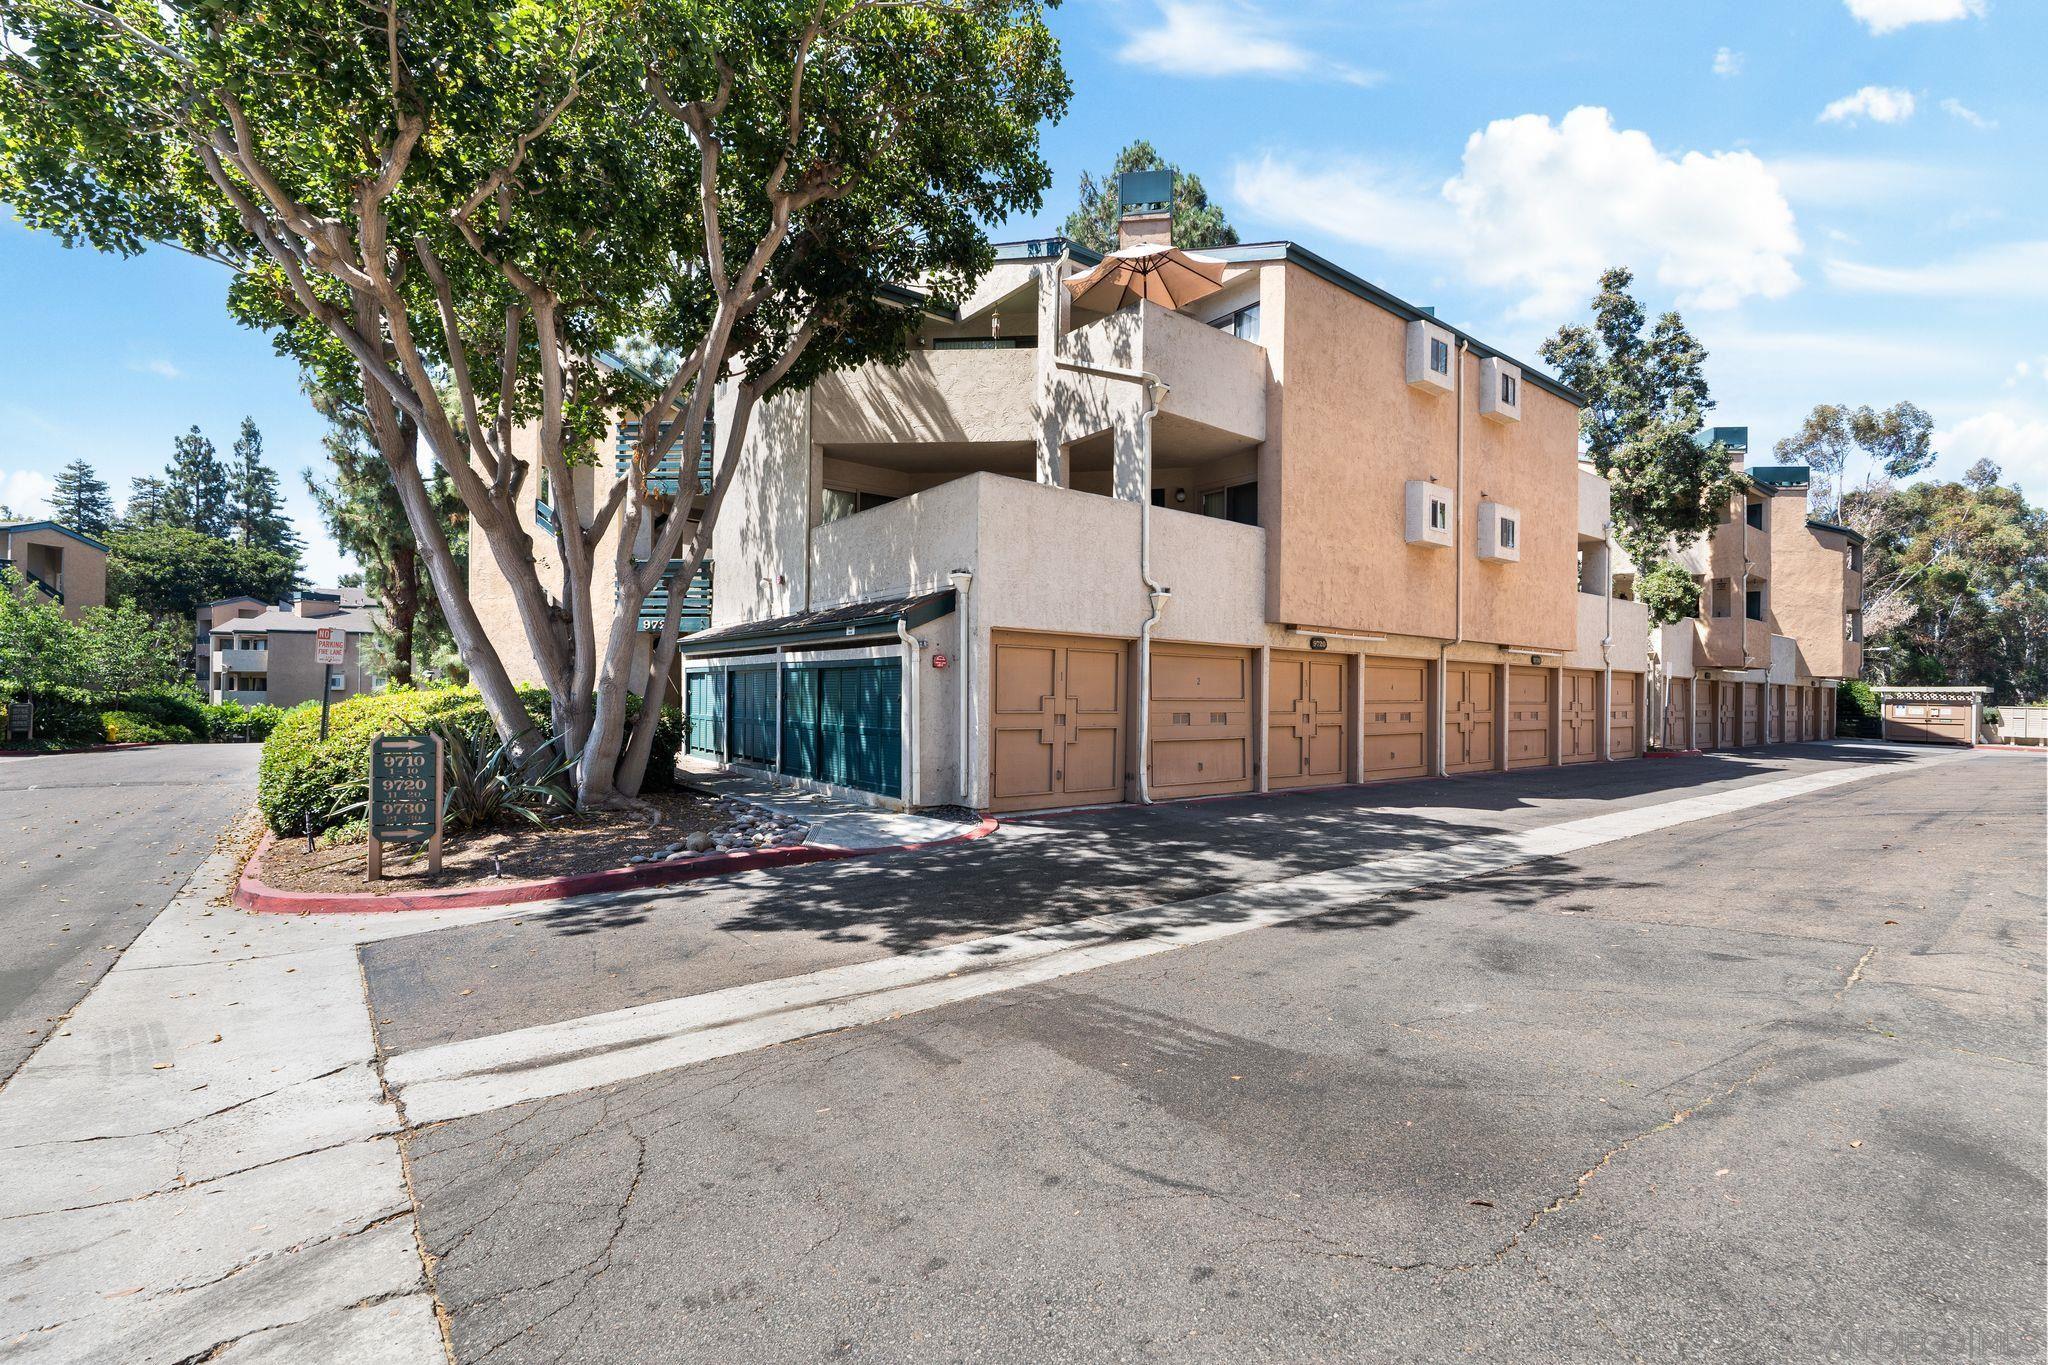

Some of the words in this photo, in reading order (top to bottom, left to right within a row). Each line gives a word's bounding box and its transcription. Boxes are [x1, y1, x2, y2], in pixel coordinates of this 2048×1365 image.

[319, 630, 330, 639] NO
[318, 640, 344, 649] PARKING
[383, 755, 426, 768] 9710
[382, 779, 427, 791] 9720
[382, 803, 426, 815] 9730
